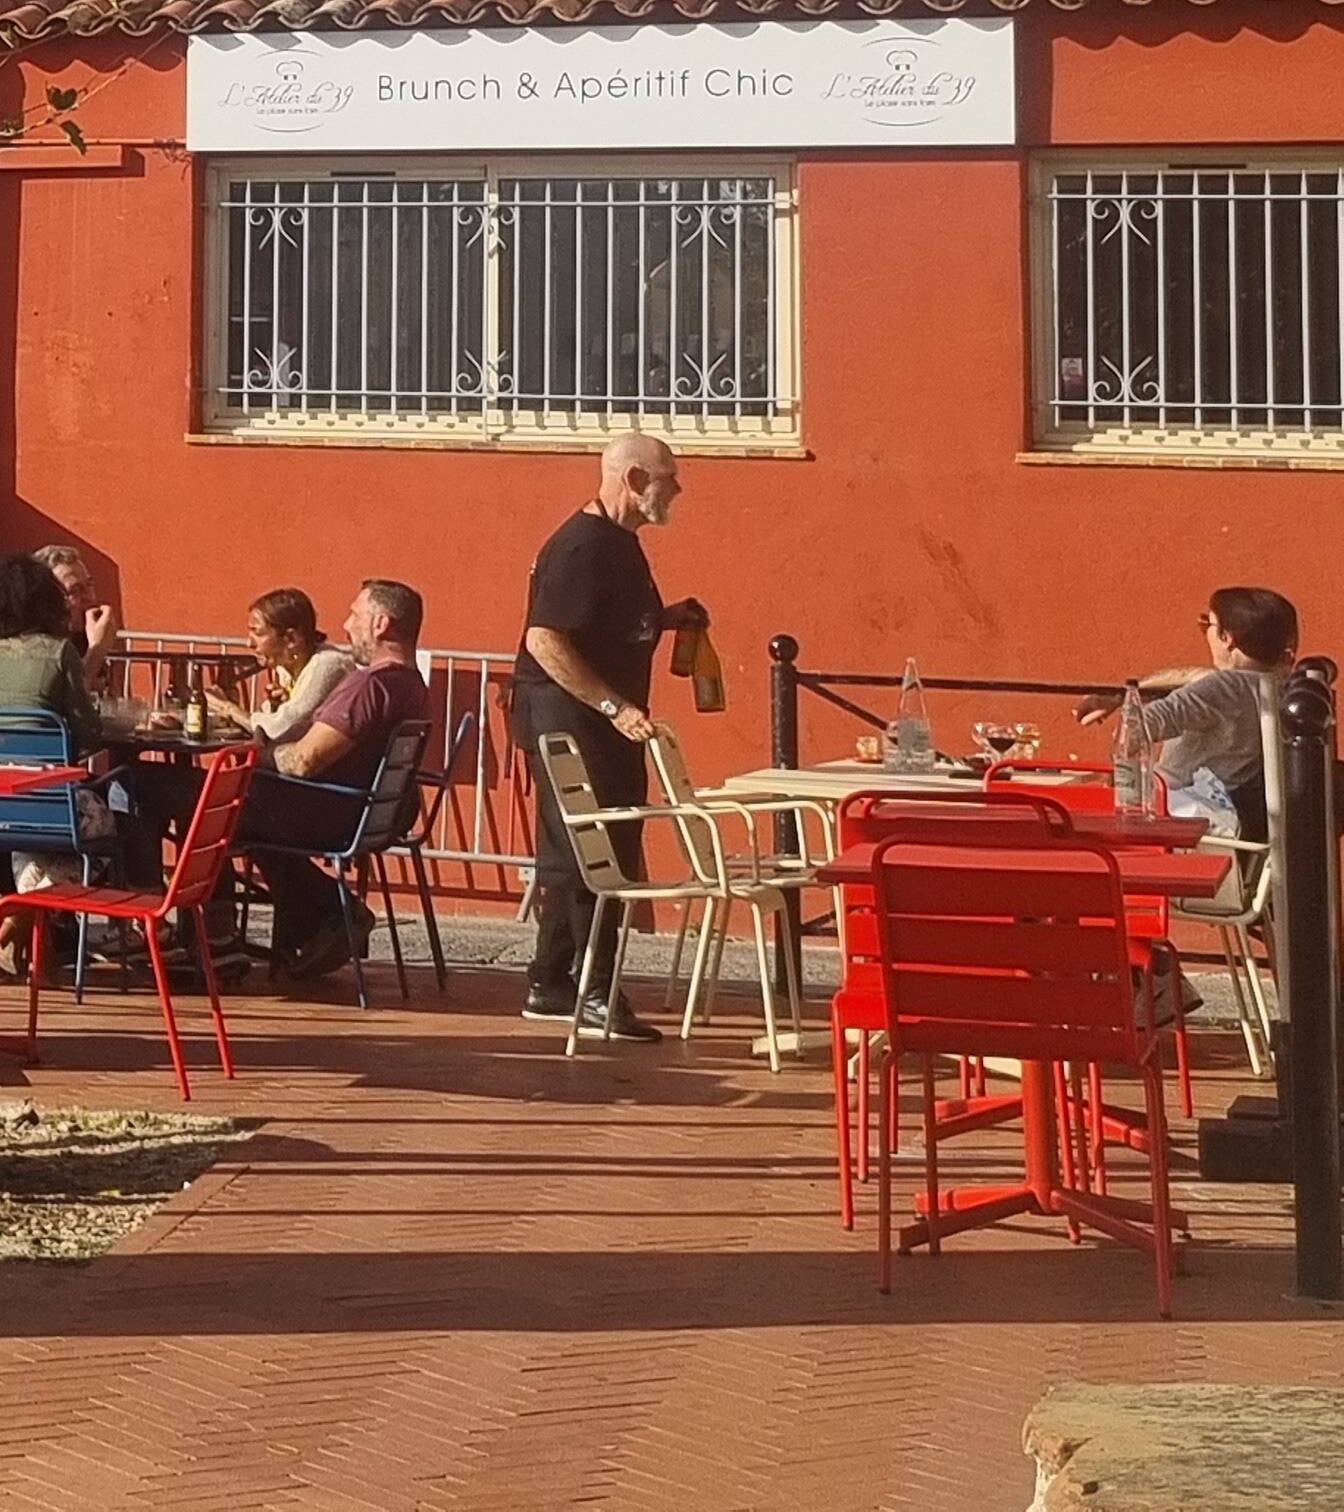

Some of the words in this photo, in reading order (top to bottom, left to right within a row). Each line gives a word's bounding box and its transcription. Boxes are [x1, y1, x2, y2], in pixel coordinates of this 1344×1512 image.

[378, 74, 501, 101] Brunch
[517, 72, 541, 100] &
[554, 68, 690, 105] Apéritif
[705, 68, 793, 97] Chic
